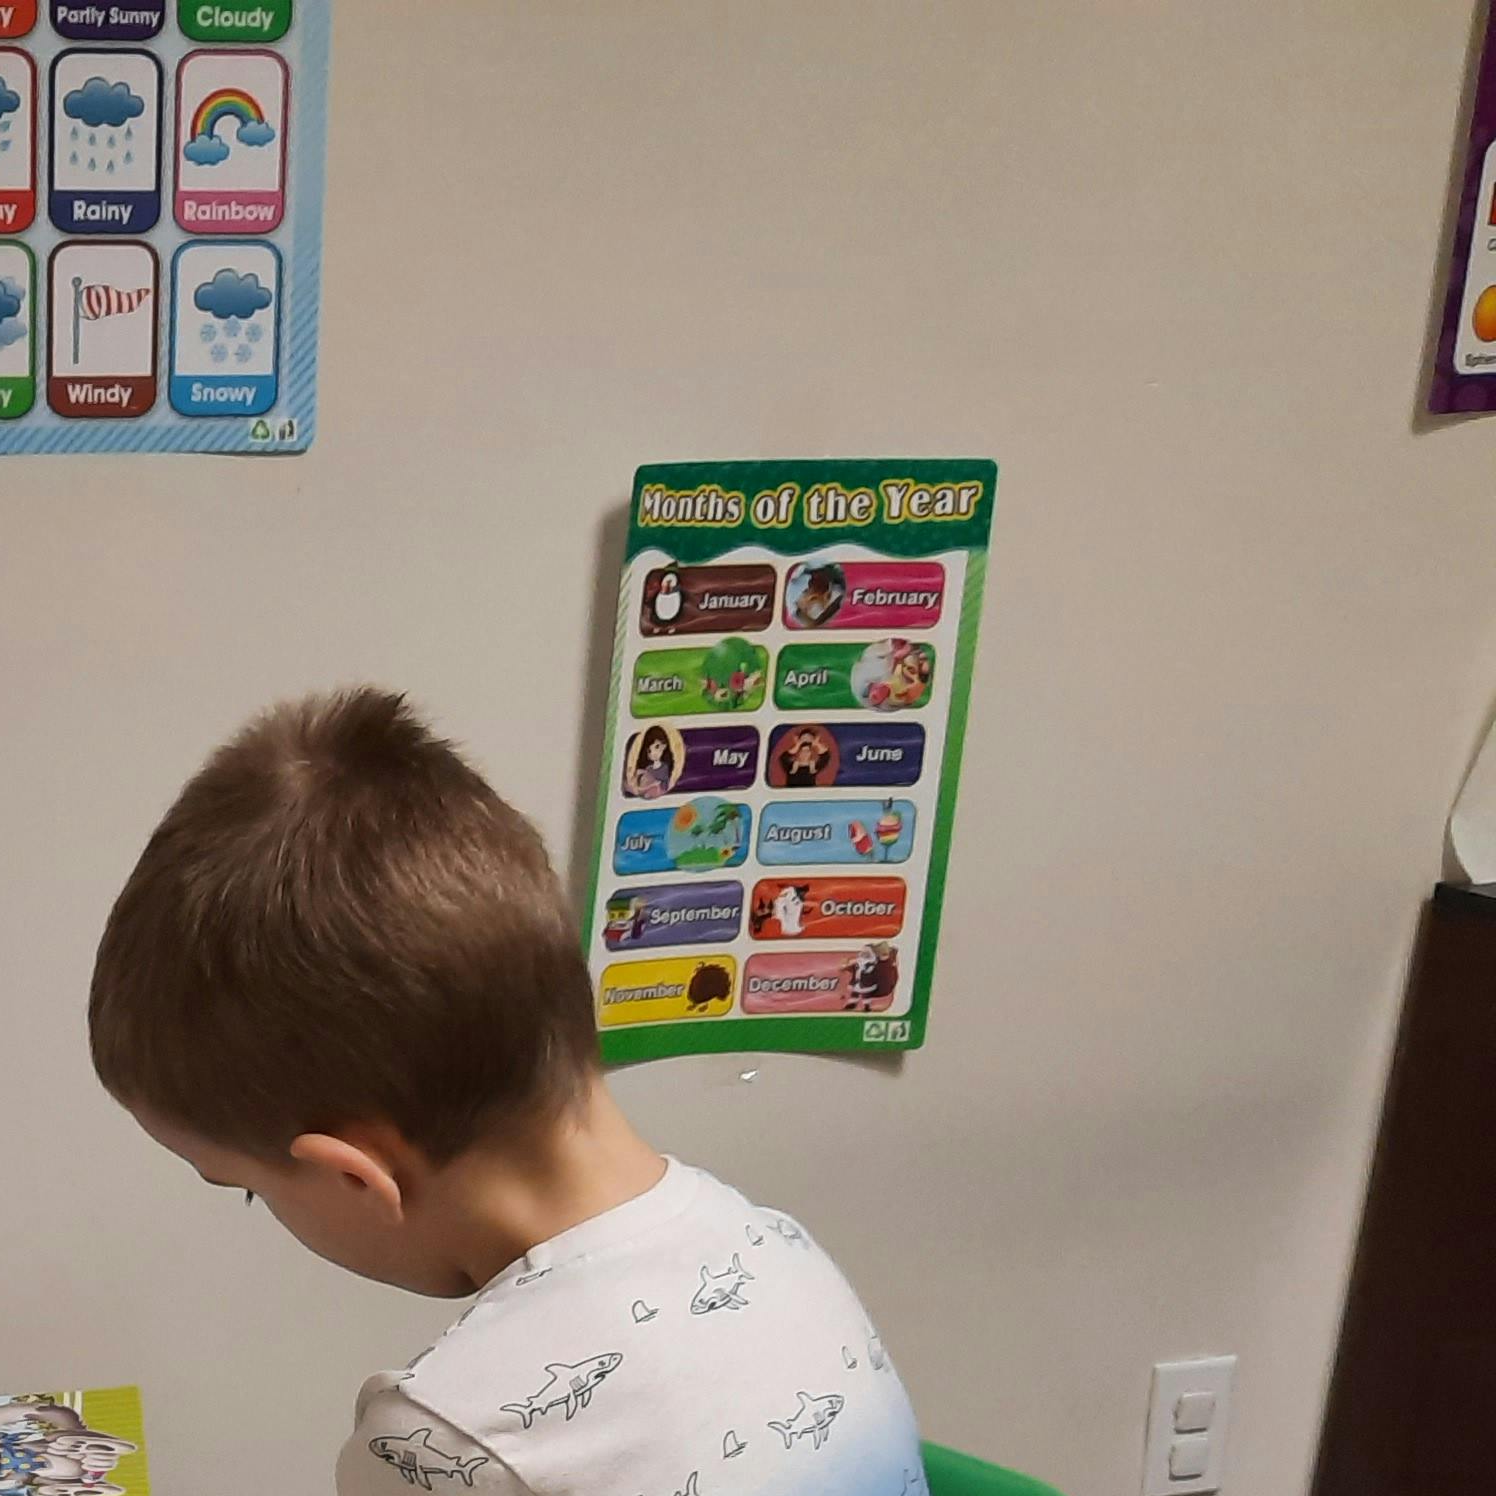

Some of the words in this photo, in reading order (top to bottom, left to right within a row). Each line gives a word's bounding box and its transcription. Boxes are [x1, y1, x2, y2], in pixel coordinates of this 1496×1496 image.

[56, 4, 106, 27] Partly
[108, 6, 162, 29] Sunny
[196, 6, 274, 31] Cloudy
[73, 201, 134, 225] Rainy
[183, 201, 276, 222] Rainbow
[67, 385, 133, 407] Windy
[191, 384, 256, 406] Snowy
[641, 485, 743, 525] Months
[752, 484, 797, 525] of
[807, 483, 873, 524] the
[882, 480, 980, 520] Year
[699, 593, 768, 611] January
[852, 589, 939, 609] February
[637, 676, 682, 693] March
[784, 669, 828, 687] April
[713, 749, 748, 767] May
[856, 746, 903, 761] June
[765, 823, 832, 842] August
[622, 834, 652, 853] July
[651, 906, 738, 925] September
[821, 900, 894, 916] October
[748, 974, 838, 993] December
[604, 984, 684, 1005] November
